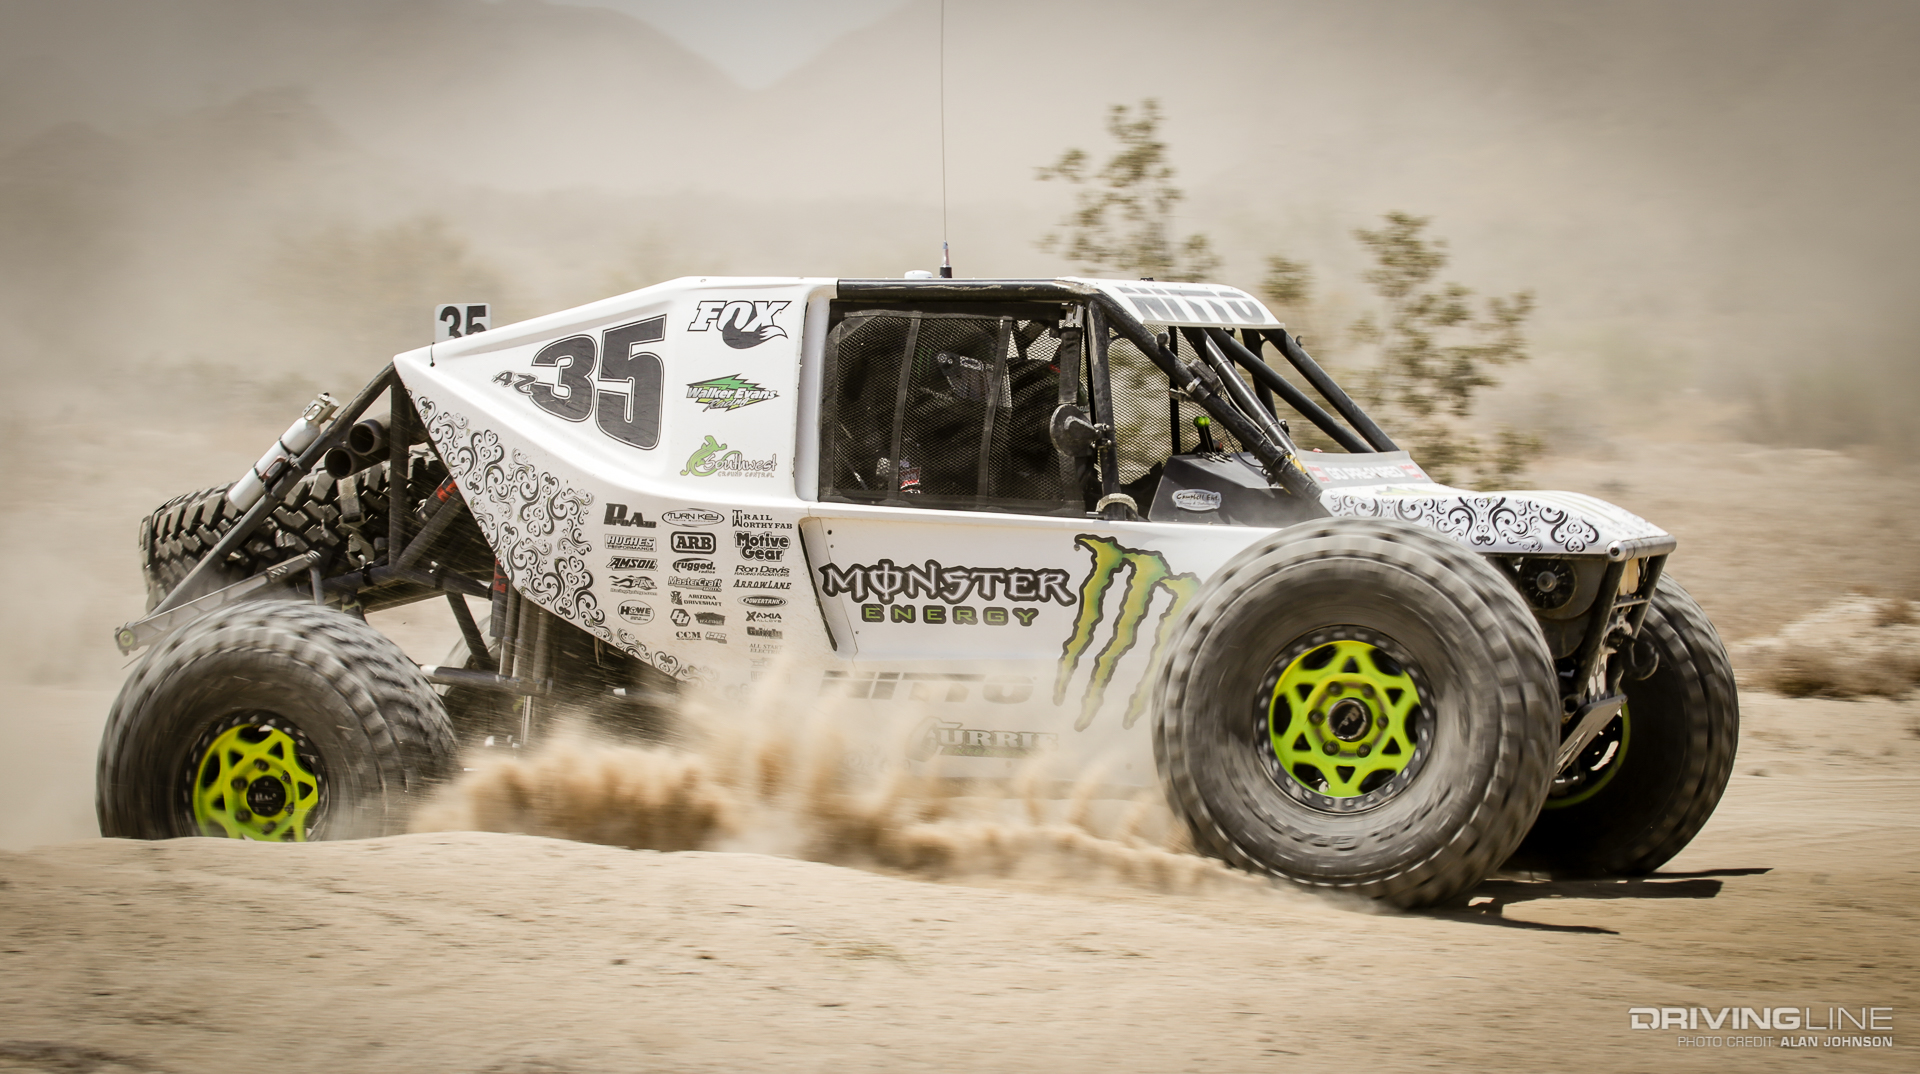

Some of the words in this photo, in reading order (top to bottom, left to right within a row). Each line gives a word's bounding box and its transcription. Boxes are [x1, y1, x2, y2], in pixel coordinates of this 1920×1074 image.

[440, 305, 487, 338] 35
[687, 300, 792, 345] FOX
[531, 313, 667, 451] 35
[686, 386, 734, 399] Walker
[734, 387, 778, 400] Evans
[704, 452, 778, 471] Southwest
[668, 512, 695, 520] TURN
[775, 522, 793, 530] FAB
[606, 535, 655, 547] HUGHES
[675, 535, 713, 550] ARB
[736, 532, 789, 548] Motive
[741, 546, 783, 561] Gear
[609, 557, 657, 570] AMSOIL
[735, 565, 758, 573] Ron
[760, 566, 790, 574] Davis
[668, 576, 723, 588] MasterCraft
[819, 558, 1077, 606] MONSTER
[620, 605, 651, 616] HOWE
[861, 603, 1039, 627] ENERGY
[675, 631, 702, 639] CCM
